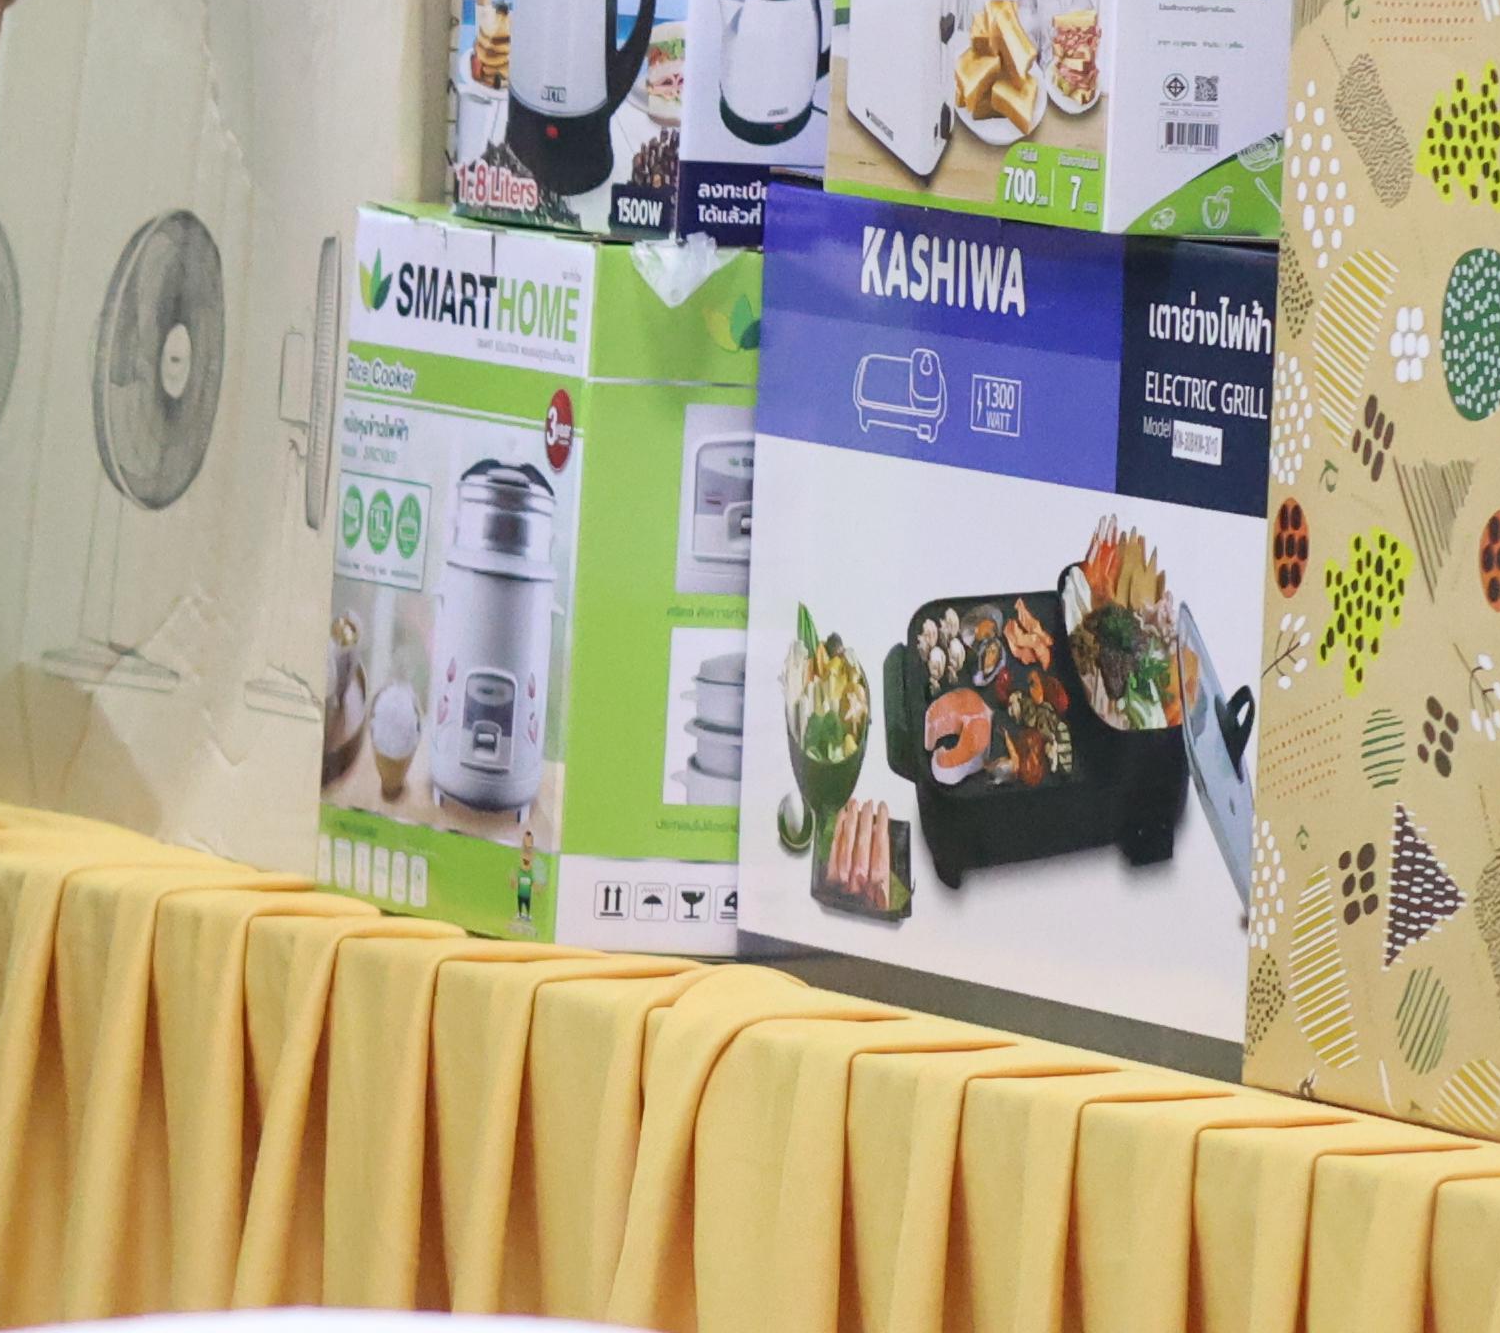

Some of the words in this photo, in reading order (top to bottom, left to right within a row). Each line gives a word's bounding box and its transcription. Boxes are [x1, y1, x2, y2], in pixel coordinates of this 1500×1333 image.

[489, 169, 539, 209] Liters
[1003, 166, 1037, 205] 700
[1070, 175, 1082, 211] 7
[617, 197, 663, 227] 1500W
[697, 202, 762, 226] ได้แล้วที่
[860, 225, 1026, 318] KASHIWA
[396, 261, 580, 343] SMARTHOME
[1148, 291, 1273, 355] เตาย่างไฟฟ้า
[371, 361, 416, 391] Cooker
[983, 381, 1015, 410] 1300
[1144, 370, 1217, 413] ELECTRIC
[1219, 382, 1268, 420] GRILL
[545, 405, 559, 446] 3
[985, 412, 1012, 432] WATT
[1143, 415, 1172, 438] Model
